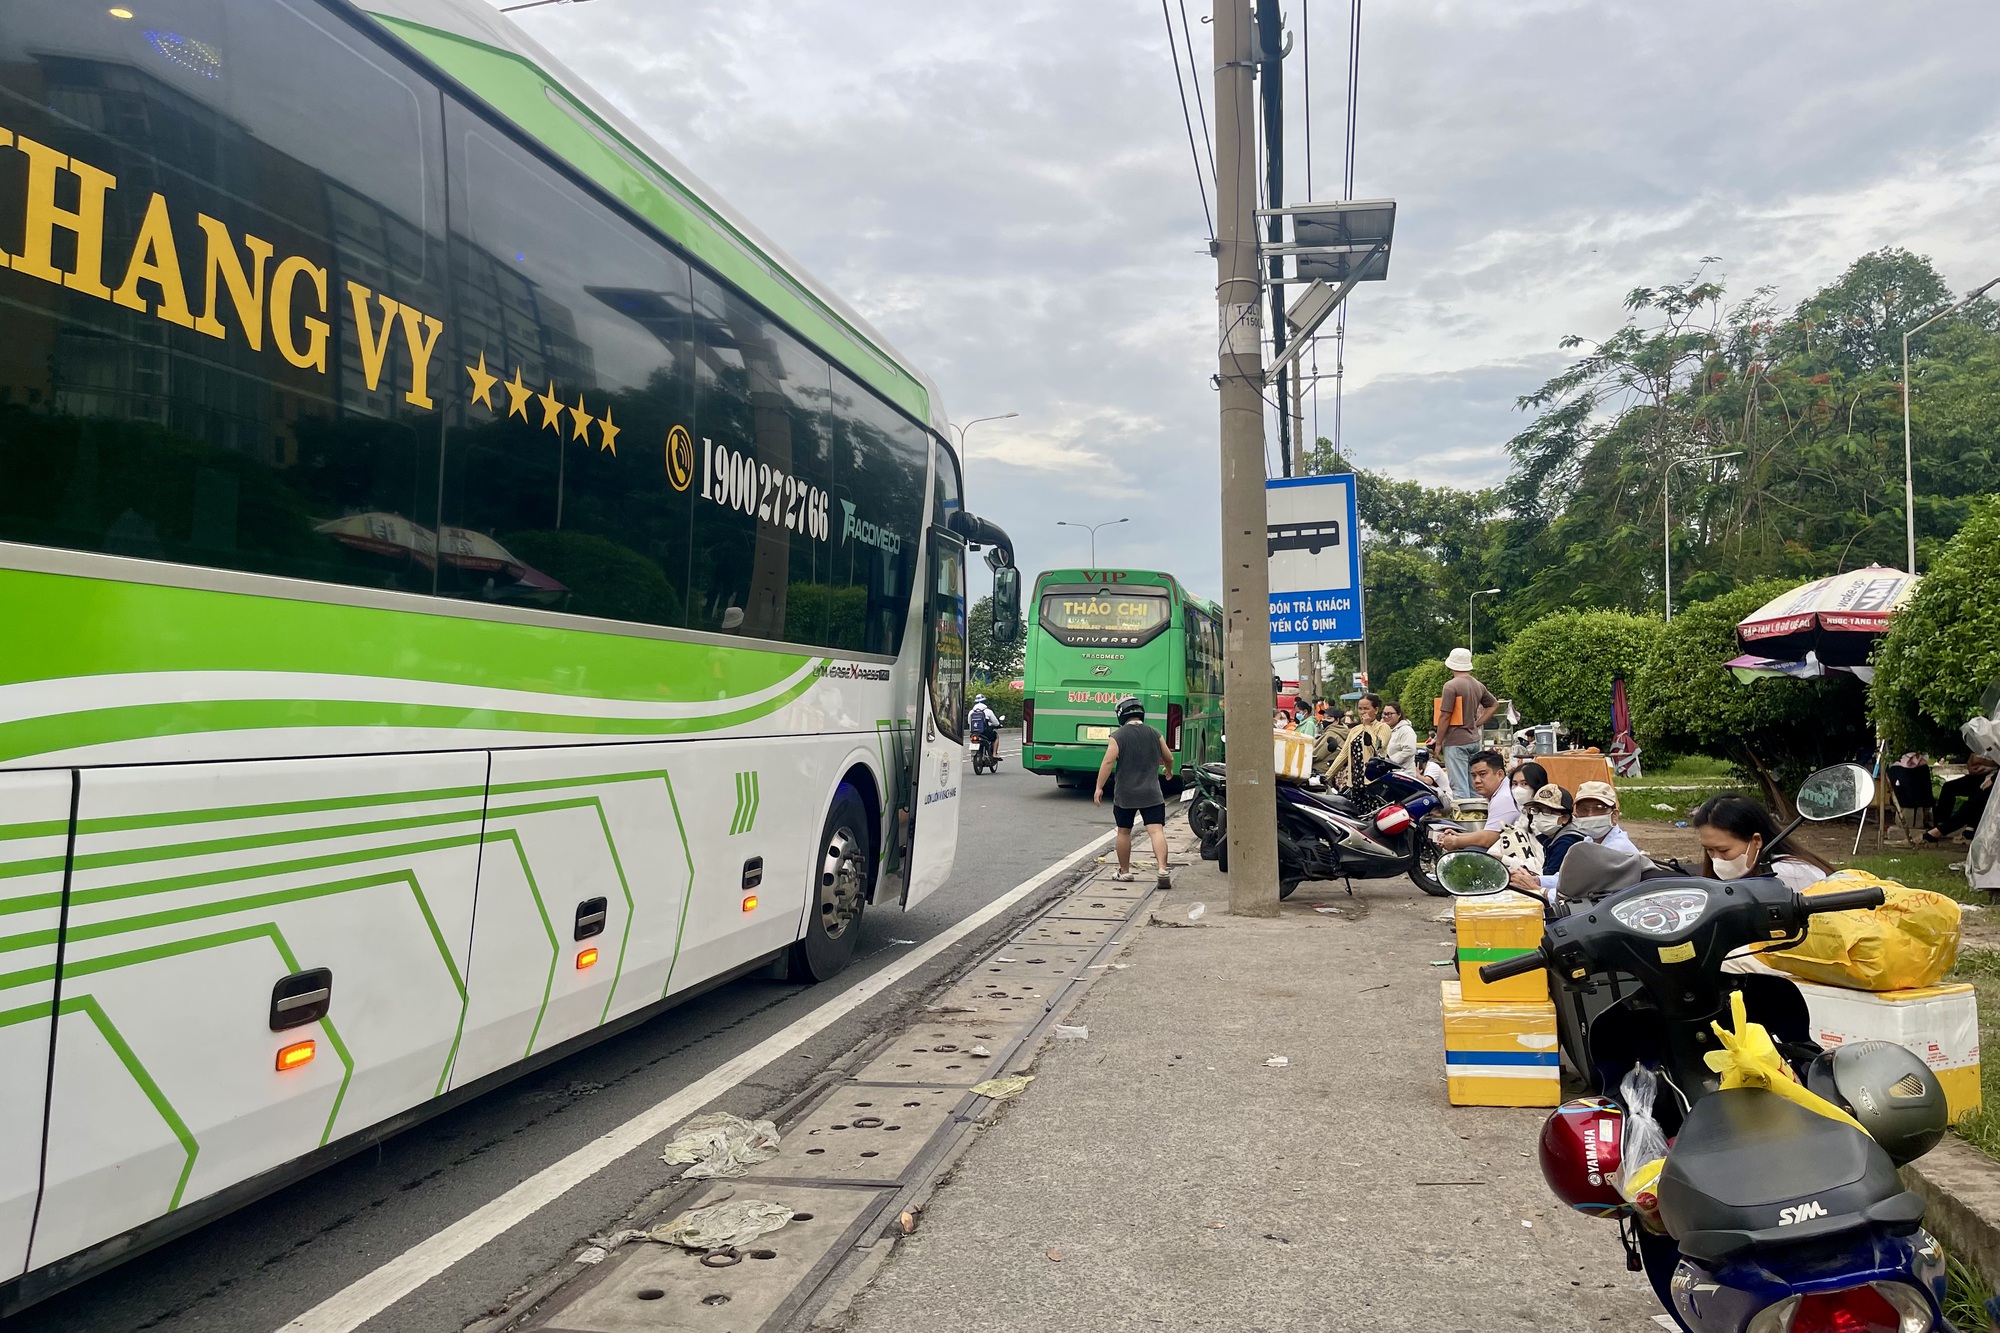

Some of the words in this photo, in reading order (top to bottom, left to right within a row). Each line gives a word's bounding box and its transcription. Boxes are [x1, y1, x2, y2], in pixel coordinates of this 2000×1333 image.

[347, 281, 443, 409] VY
[701, 437, 829, 542] 1900272766
[840, 498, 901, 555] TRACOMECO
[1081, 570, 1127, 583] VIP
[1063, 597, 1112, 616] THẢO
[1117, 602, 1148, 616] CHI
[1269, 600, 1291, 614] ĐÓN
[1293, 596, 1313, 613] TRẢ
[1315, 596, 1351, 612] KHÁCH
[1294, 615, 1310, 632] CỐ
[1312, 618, 1337, 633] ĐỊNH
[1067, 636, 1138, 644] UNIVERSE
[1081, 653, 1125, 661] TRACOMECO
[1584, 1129, 1600, 1173] YAMAHA
[1778, 1200, 1828, 1227] SYM
